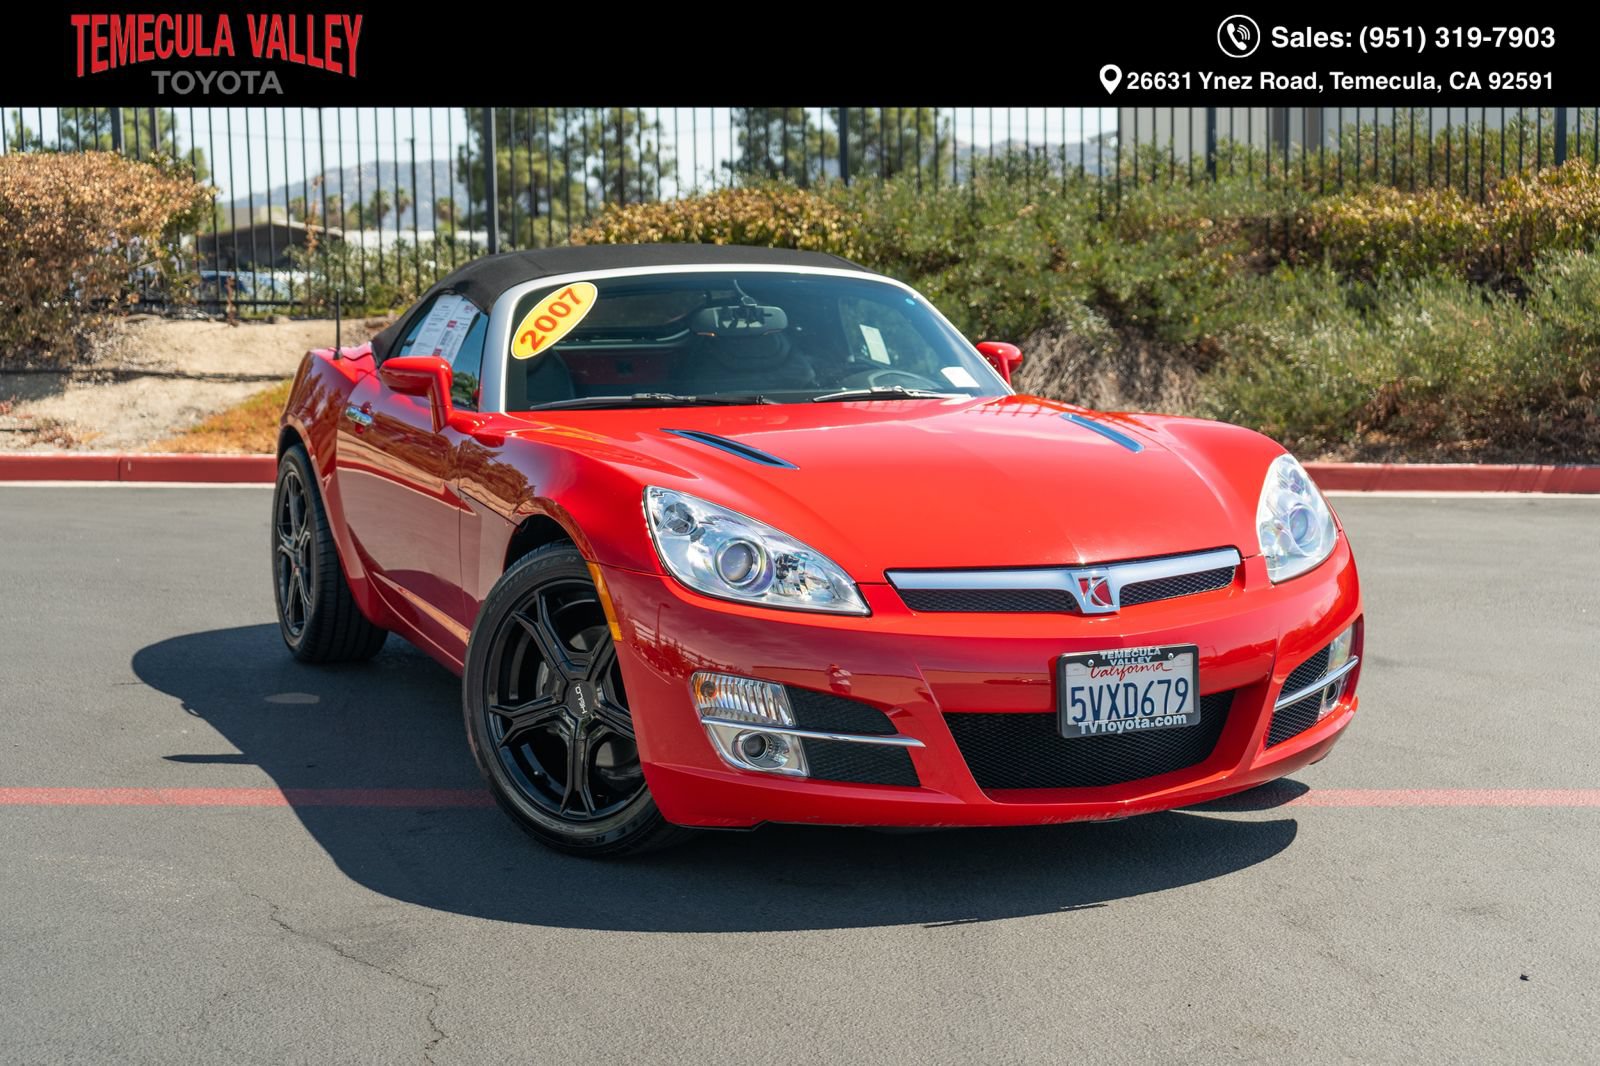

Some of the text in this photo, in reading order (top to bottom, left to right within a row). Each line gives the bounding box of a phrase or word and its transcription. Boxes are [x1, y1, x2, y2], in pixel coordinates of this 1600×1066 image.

[520, 287, 581, 351] 2007
[1101, 647, 1161, 660] TEMECULA
[1110, 656, 1152, 666] VALLEY
[1090, 662, 1172, 681] California
[1071, 677, 1189, 723] 5VXD679
[1078, 714, 1187, 734] TVToyota.com
